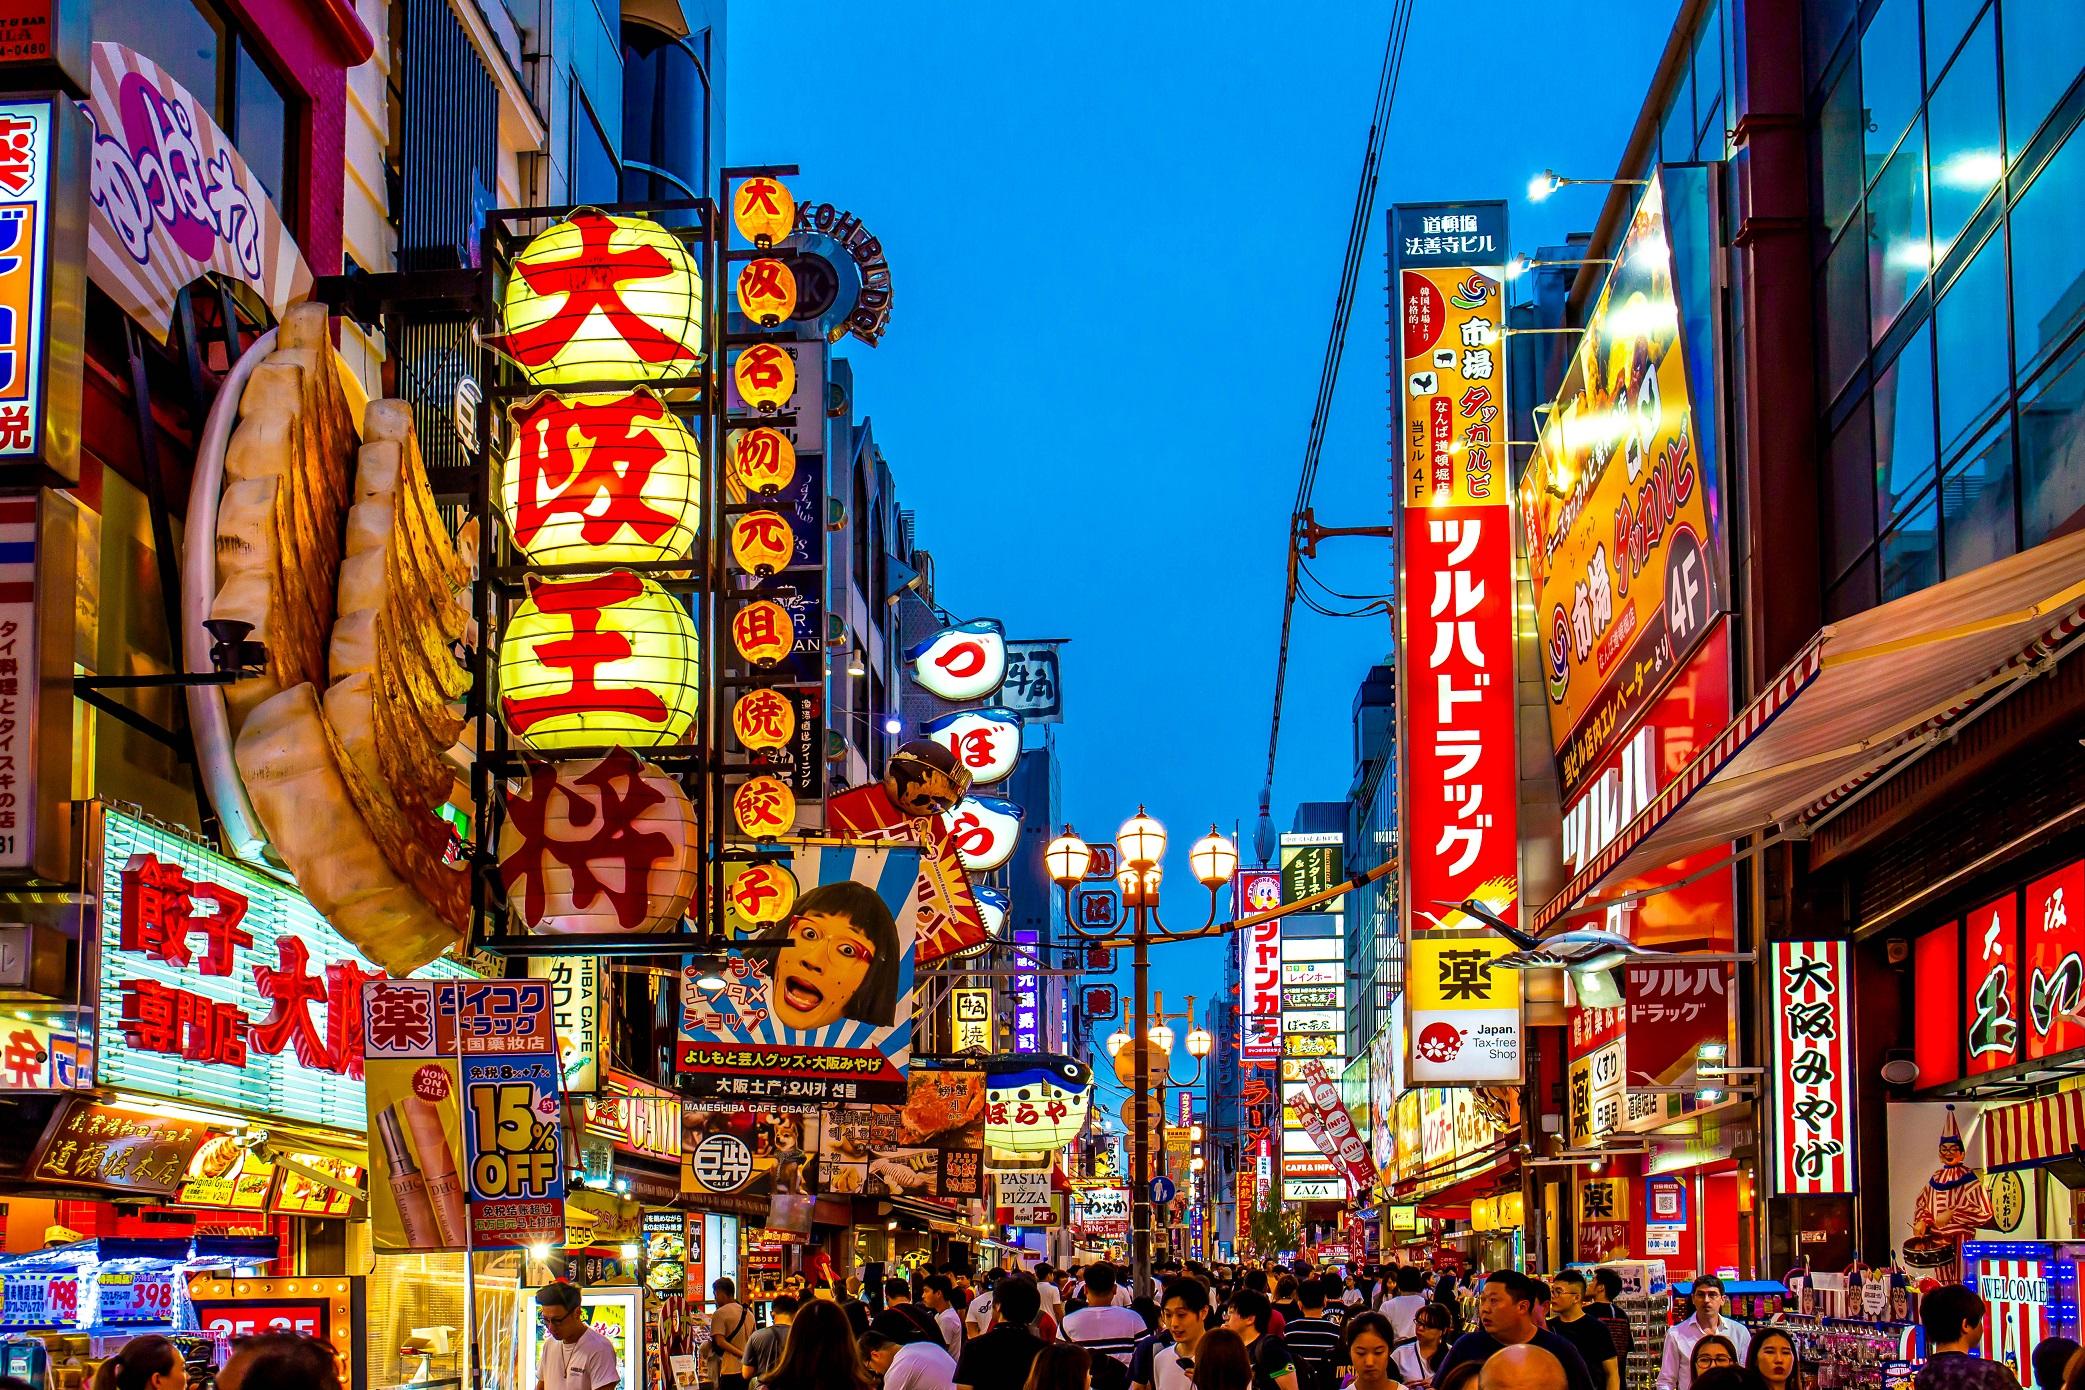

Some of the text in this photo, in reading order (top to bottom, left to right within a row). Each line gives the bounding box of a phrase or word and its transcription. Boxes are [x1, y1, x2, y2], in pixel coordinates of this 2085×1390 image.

[1422, 214, 1478, 234] 道頓堀
[1405, 235, 1497, 255] 法善寺ビル
[478, 209, 702, 930] 大阪王将
[1670, 548, 1699, 639] 4F
[1002, 664, 1053, 702] 牛角
[1428, 519, 1493, 878] ツルハドラッグ
[120, 853, 253, 977] 餃子
[1438, 948, 1492, 1000] 薬
[1630, 968, 1724, 997] ツルハ
[683, 1007, 769, 1034] ショップ
[1630, 1002, 1706, 1024] ドラッグ
[581, 1005, 593, 1053] CAFE
[1472, 1037, 1517, 1048] Tax-free
[1489, 1048, 1517, 1060] Shop
[418, 1067, 448, 1081] NOW
[1596, 1050, 1618, 1080] くすり
[1785, 956, 1843, 1179] 大阪みやげ
[416, 1085, 448, 1099] SALE!
[422, 1078, 443, 1091] ON
[1316, 1088, 1334, 1101] CAFE
[684, 1102, 818, 1115] MAMESHIBA CAFE OSAKA
[1327, 1114, 1347, 1129] INFO
[1342, 1140, 1361, 1154] LIVE
[475, 1152, 554, 1197] OFF
[1001, 1173, 1048, 1185] PASTA
[1001, 1191, 1048, 1205] PIZZA
[1292, 1185, 1329, 1196] ZAZA
[1583, 1182, 1613, 1218] 薬
[131, 1283, 172, 1309] 398
[1982, 1276, 2047, 1303] WELCOME
